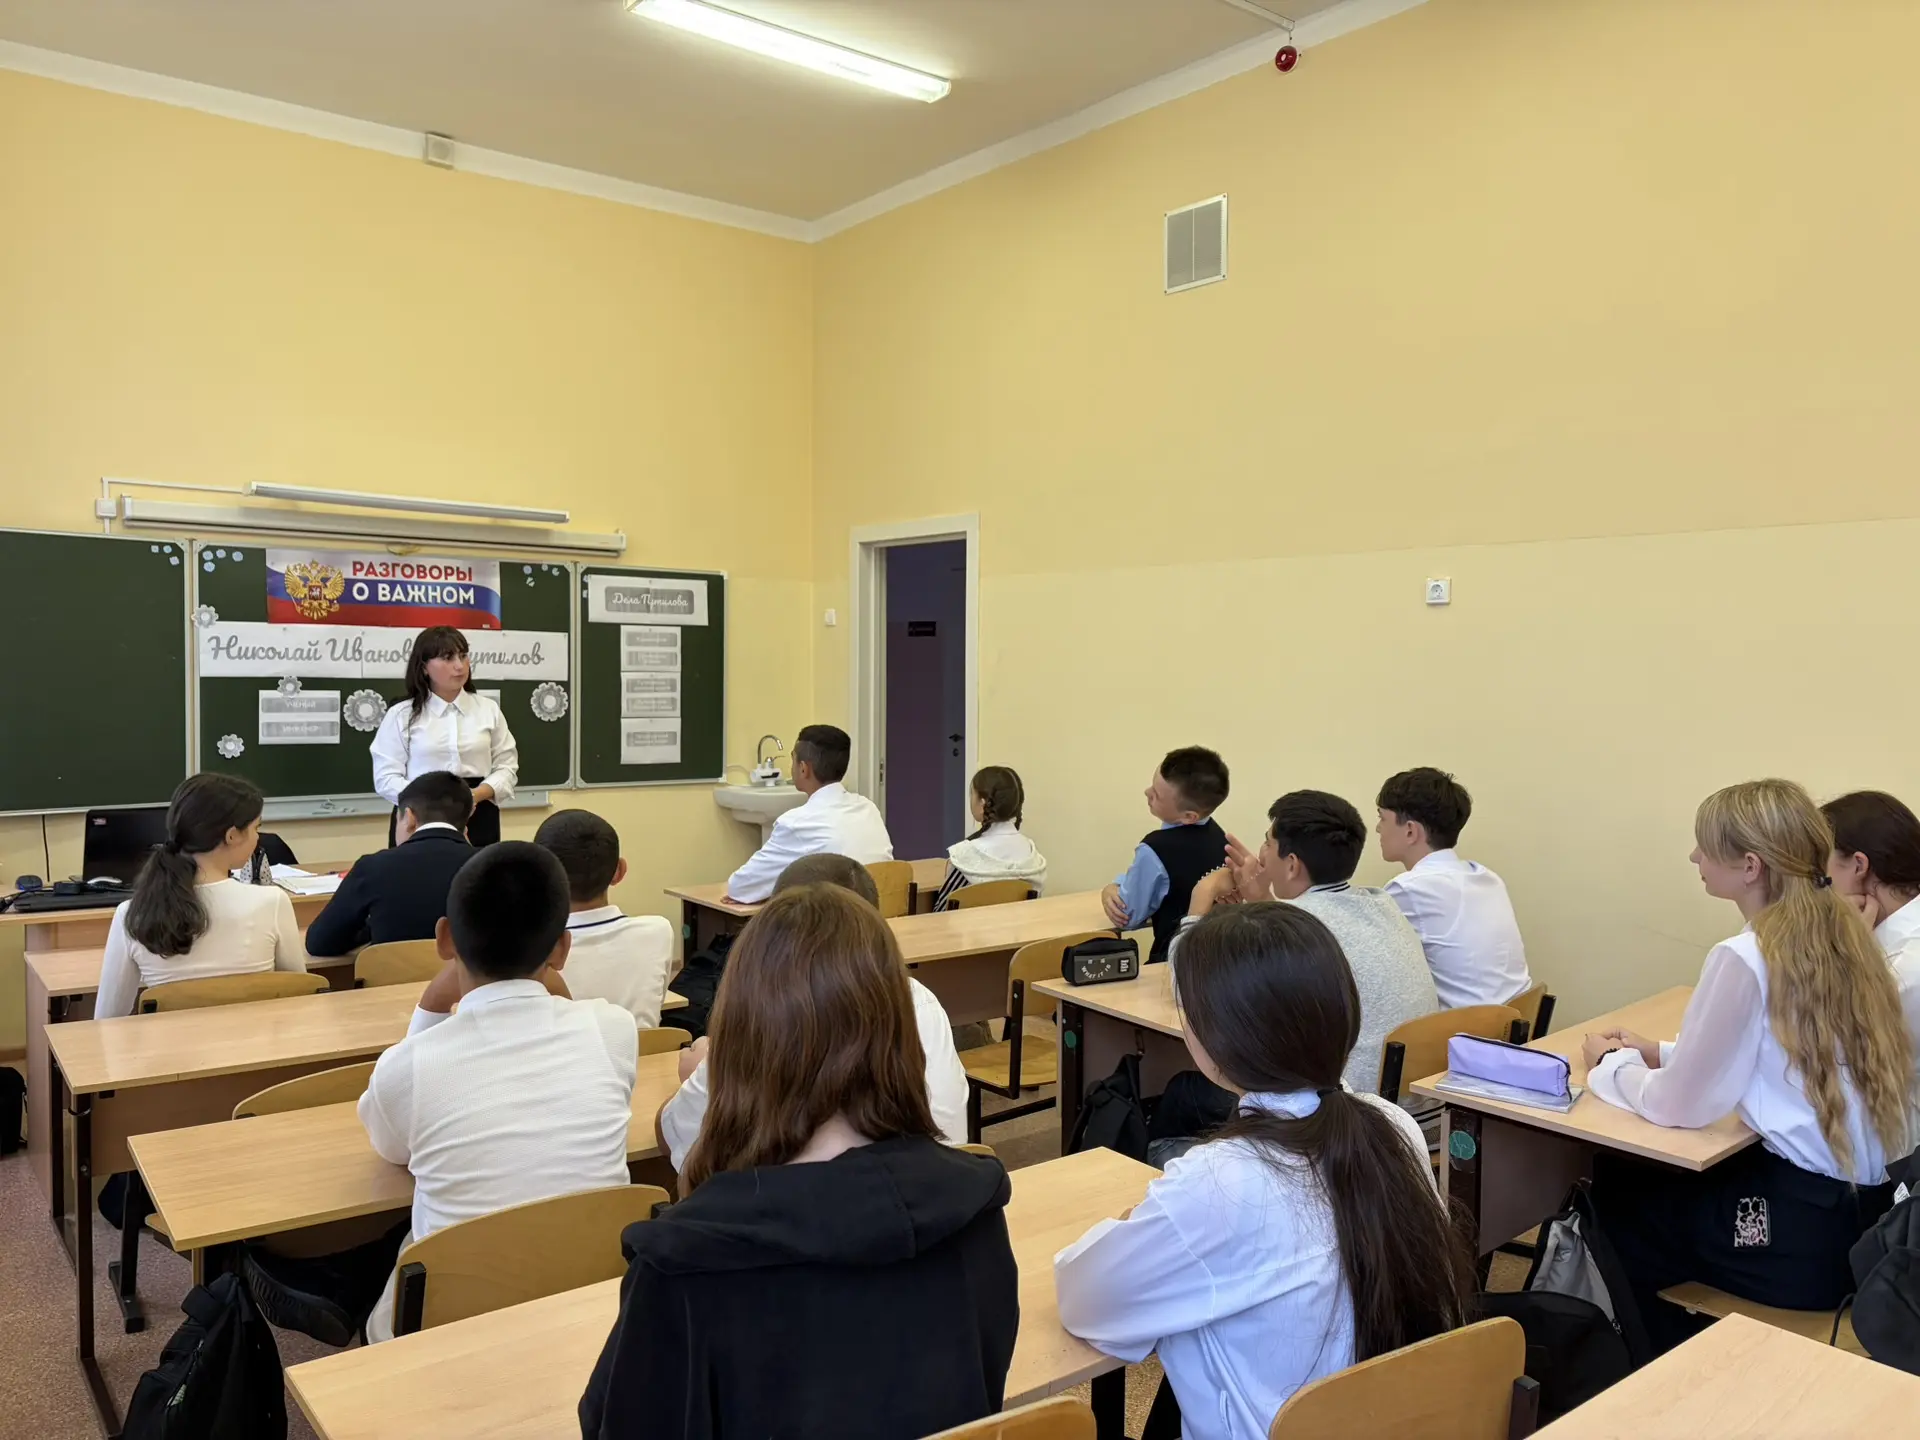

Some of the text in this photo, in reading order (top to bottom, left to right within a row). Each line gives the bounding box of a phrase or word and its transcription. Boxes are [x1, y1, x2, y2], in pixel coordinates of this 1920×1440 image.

[352, 561, 473, 582] РАЗГОВОРЫ
[352, 582, 475, 605] О ВАЖНОМ
[612, 592, 689, 610] Дела Путилова
[207, 635, 545, 673] Николай Иванов утилов
